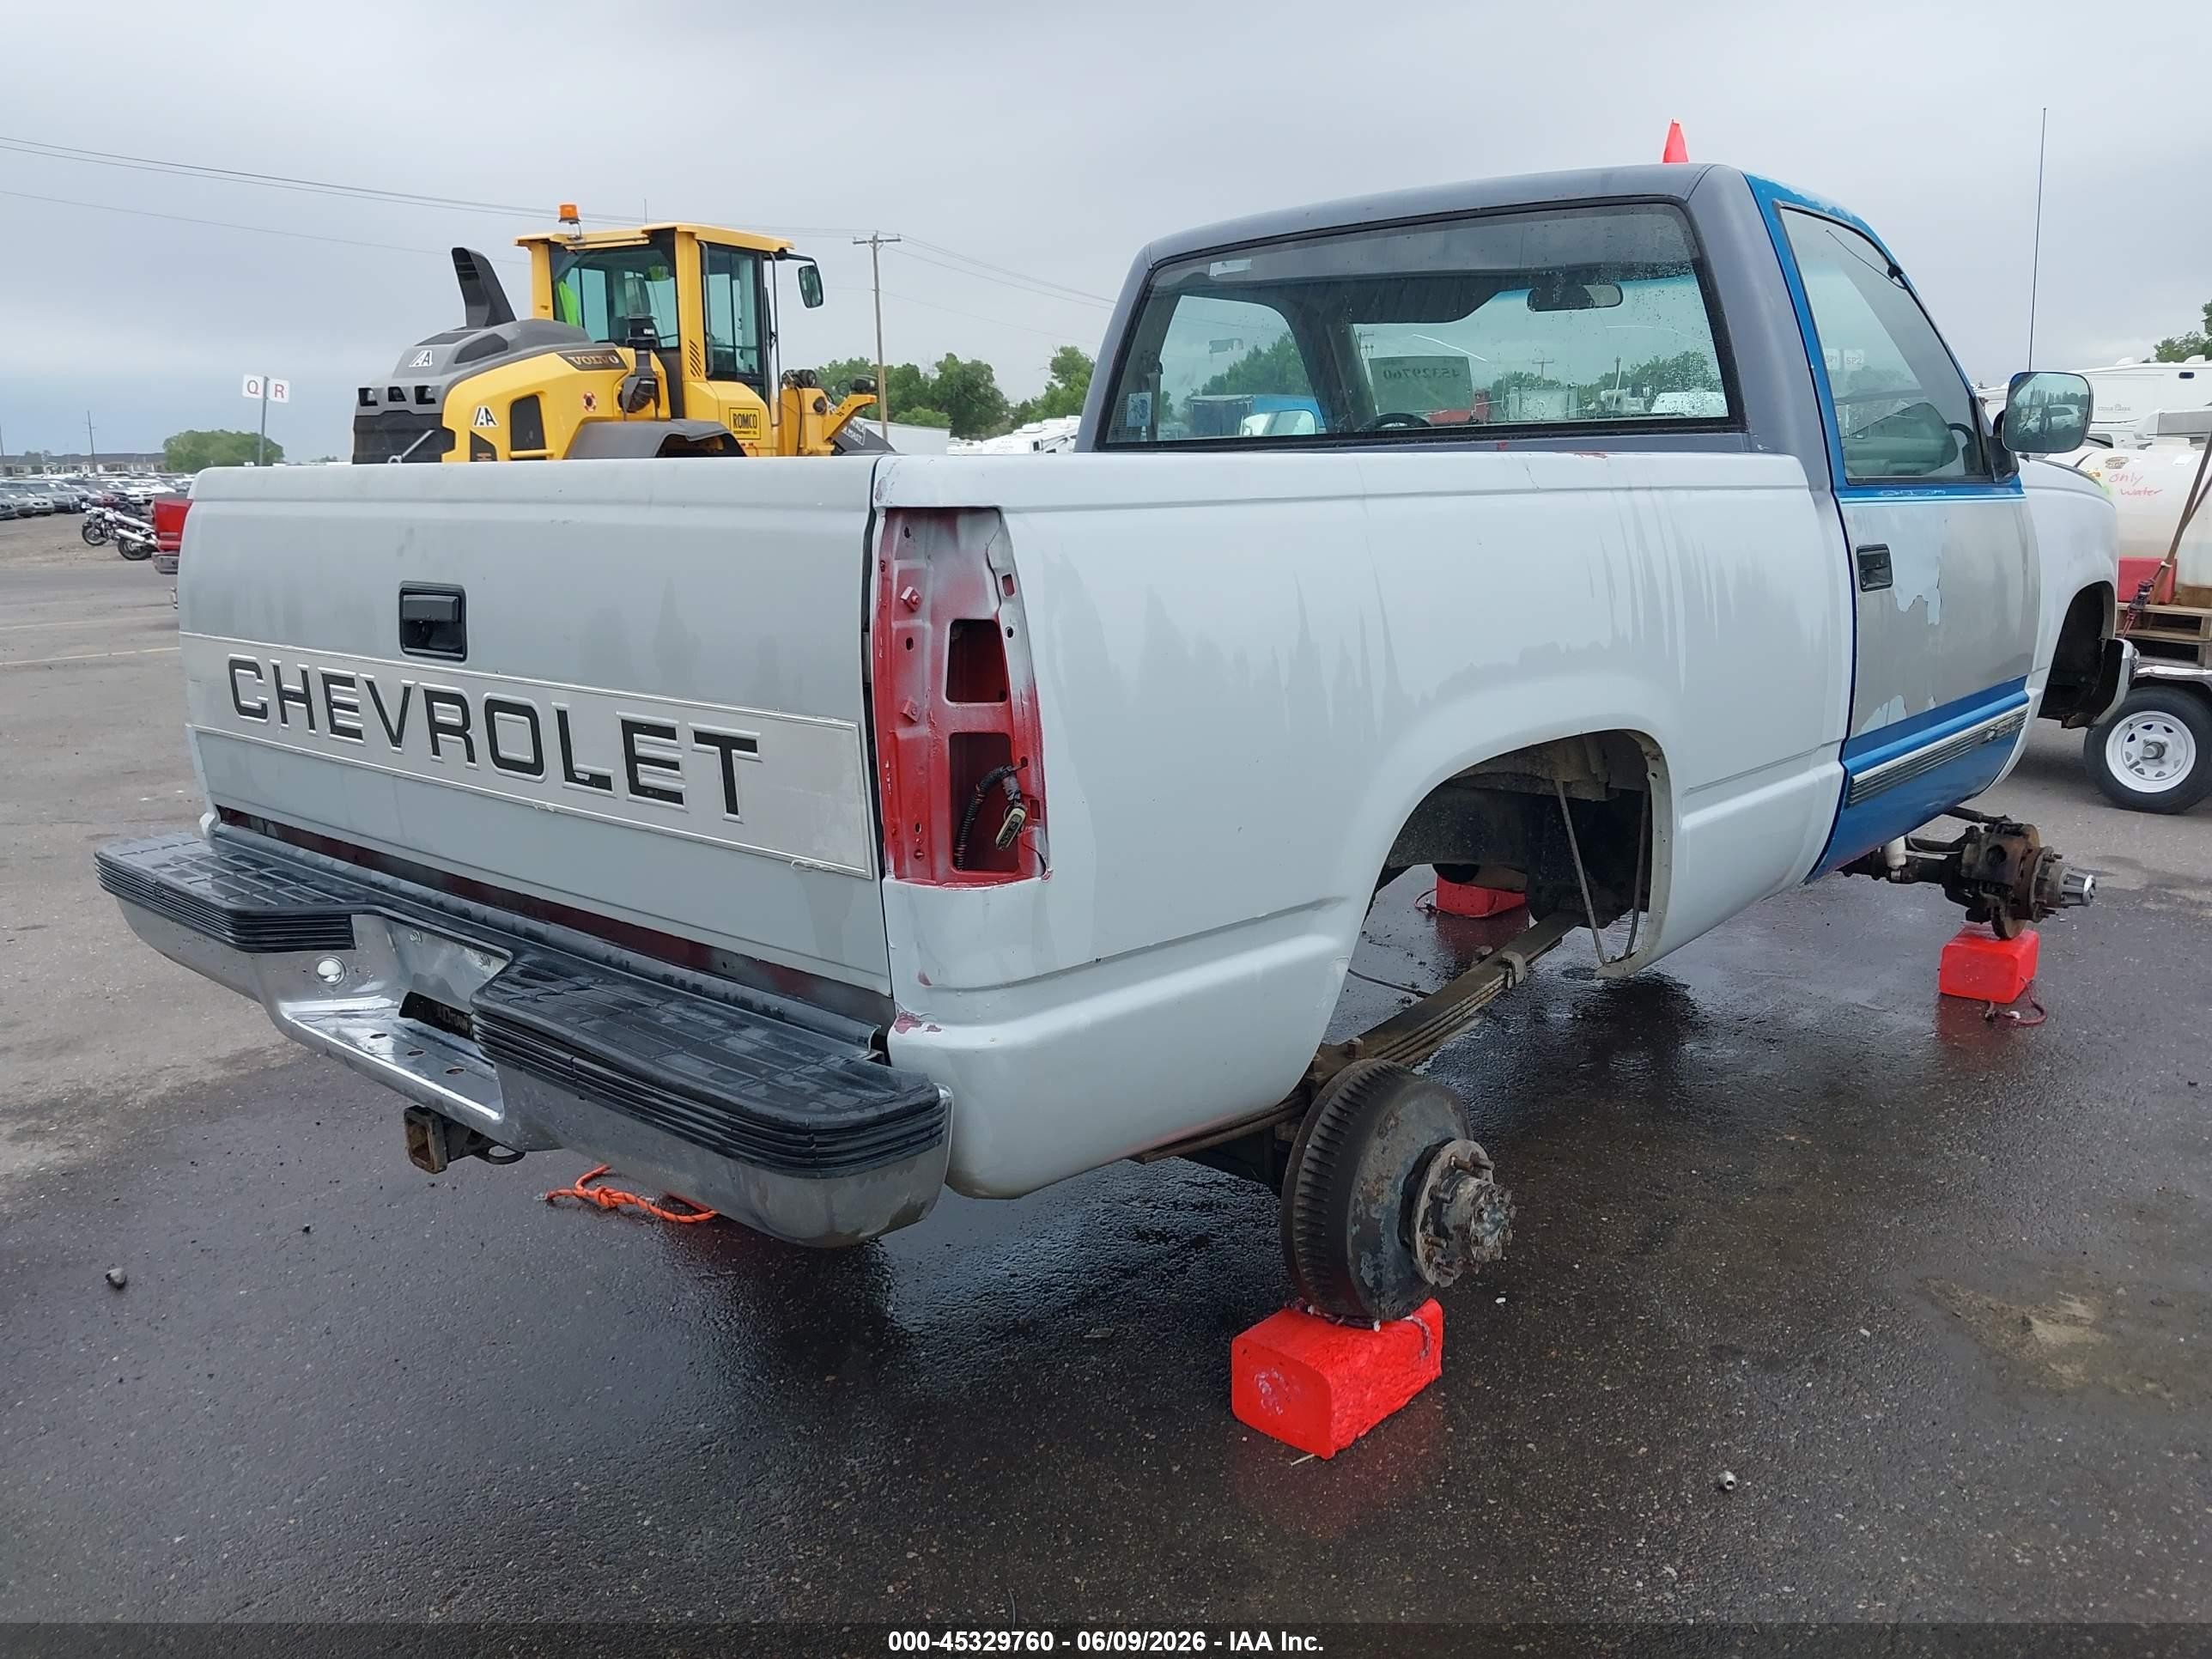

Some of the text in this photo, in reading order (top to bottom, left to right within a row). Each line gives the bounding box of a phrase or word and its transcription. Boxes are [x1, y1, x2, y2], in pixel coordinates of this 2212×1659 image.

[567, 355, 619, 365] VOLVO
[1846, 356, 1863, 365] SP2
[246, 380, 259, 395] Q
[274, 383, 285, 399] R
[732, 413, 758, 429] ROMCO
[2119, 487, 2163, 496] water
[228, 654, 763, 822] CHEVROLET
